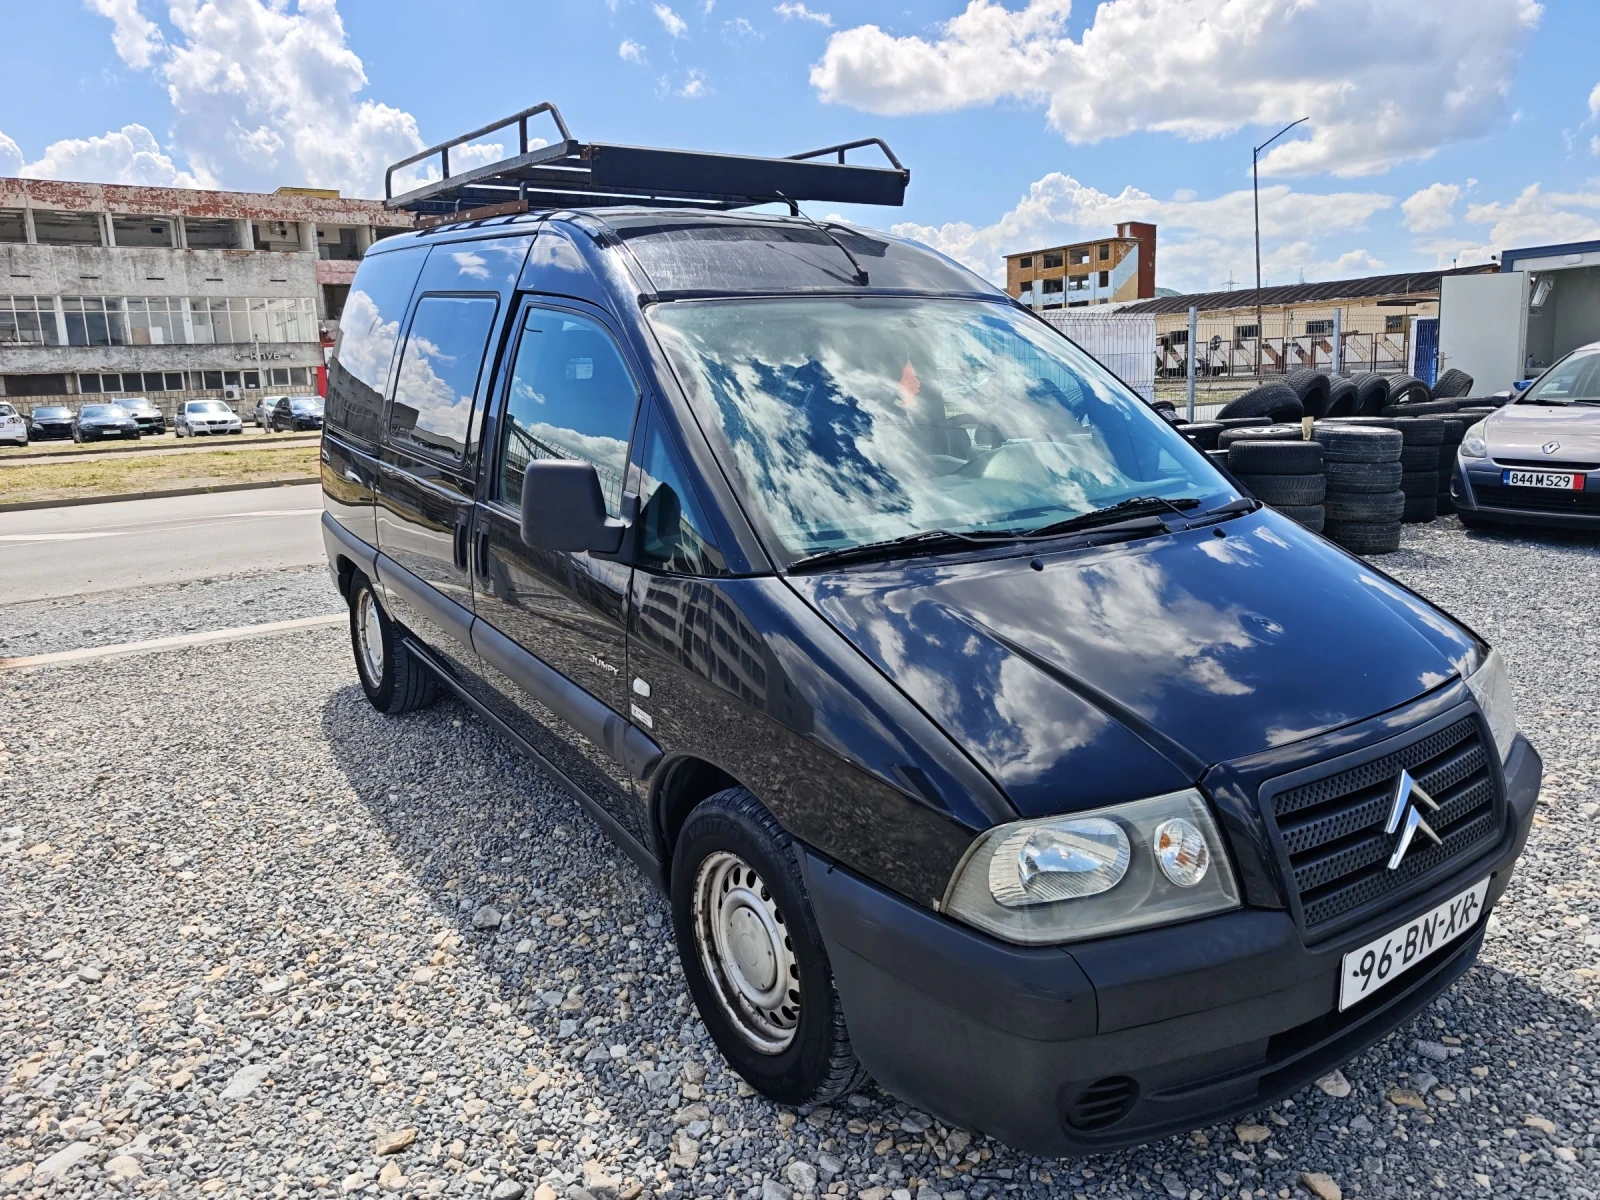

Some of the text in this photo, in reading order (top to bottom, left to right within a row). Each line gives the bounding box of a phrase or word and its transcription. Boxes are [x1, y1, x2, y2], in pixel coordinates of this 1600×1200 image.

[250, 352, 281, 360] КЛУБ
[1511, 473, 1570, 487] 844M529
[589, 655, 619, 676] JUMPY
[1359, 891, 1476, 992] 96-BN-XR
